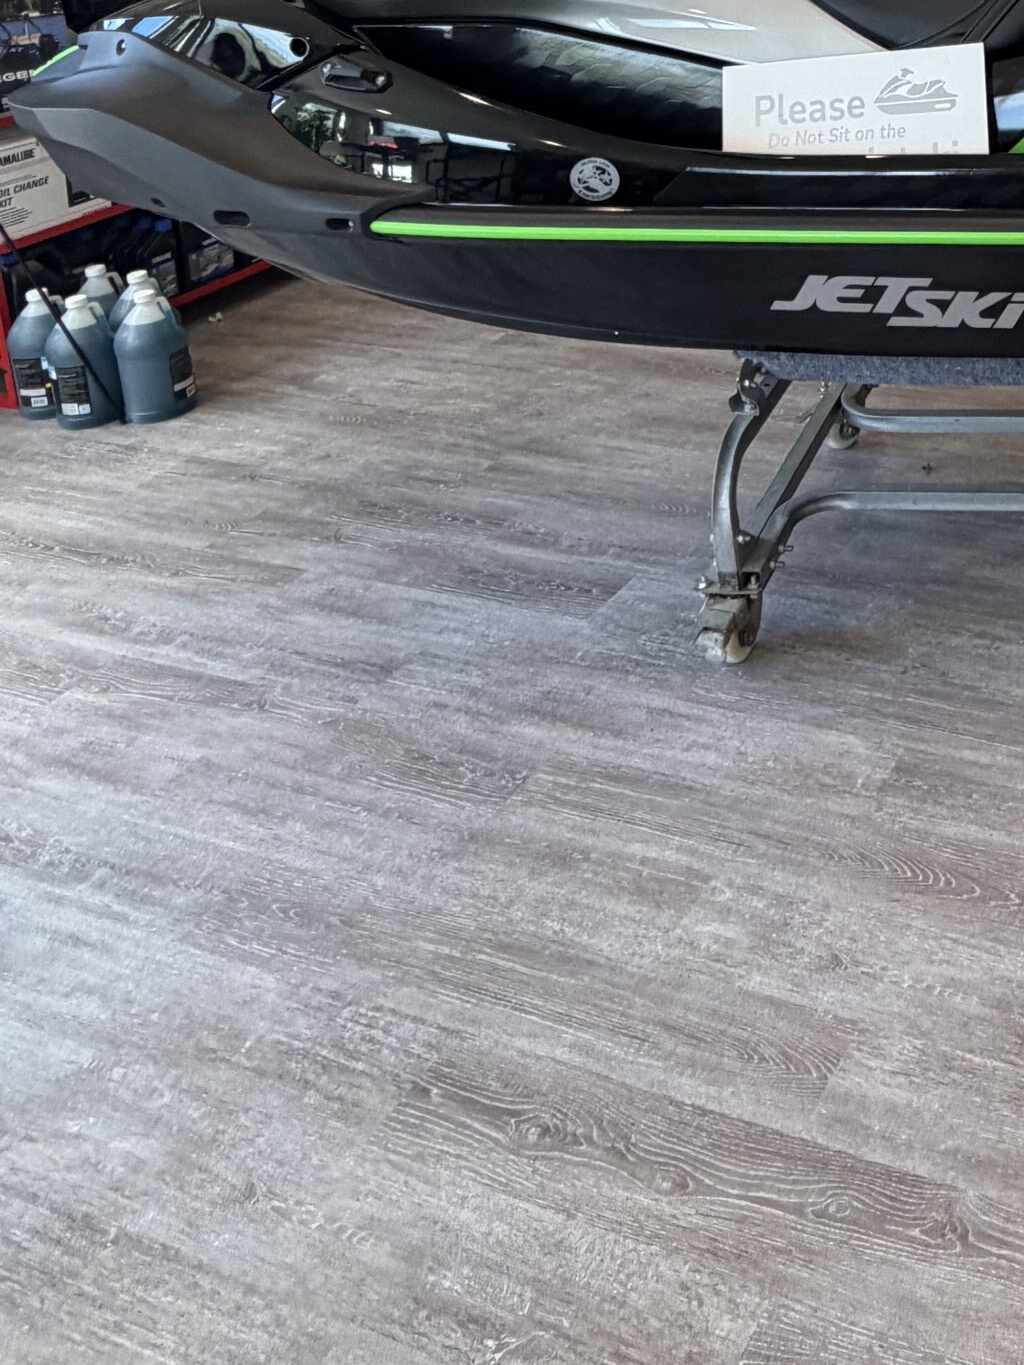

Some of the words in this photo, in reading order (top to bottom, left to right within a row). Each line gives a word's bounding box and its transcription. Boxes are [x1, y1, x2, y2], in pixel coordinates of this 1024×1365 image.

[754, 93, 866, 127] Please
[768, 132, 790, 149] Do
[795, 129, 824, 147] Not
[828, 125, 851, 143] Sit
[855, 126, 874, 140] on
[879, 122, 907, 139] the
[13, 176, 49, 195] CHANGE
